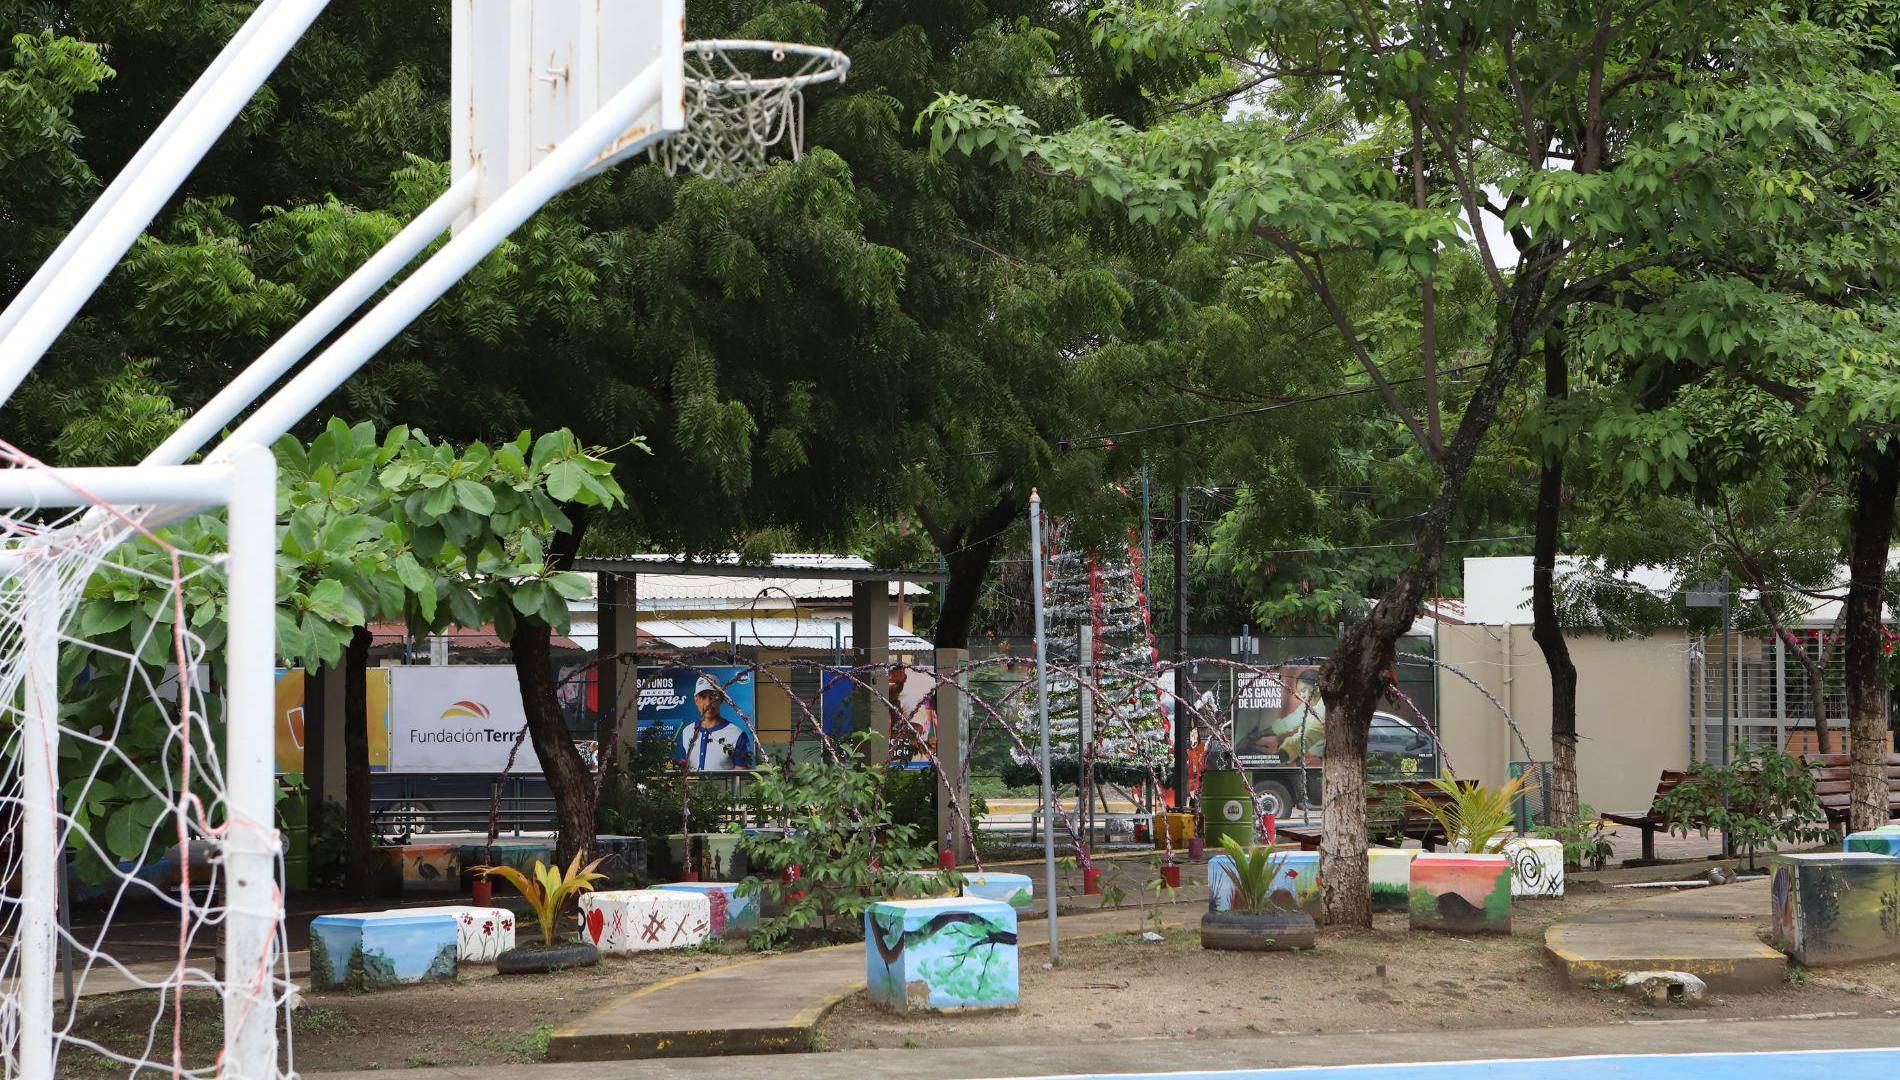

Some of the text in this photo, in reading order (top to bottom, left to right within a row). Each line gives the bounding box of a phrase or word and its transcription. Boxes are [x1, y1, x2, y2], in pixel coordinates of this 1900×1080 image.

[1254, 688, 1282, 698] GANAS
[1238, 699, 1282, 709] DE LUCHAR
